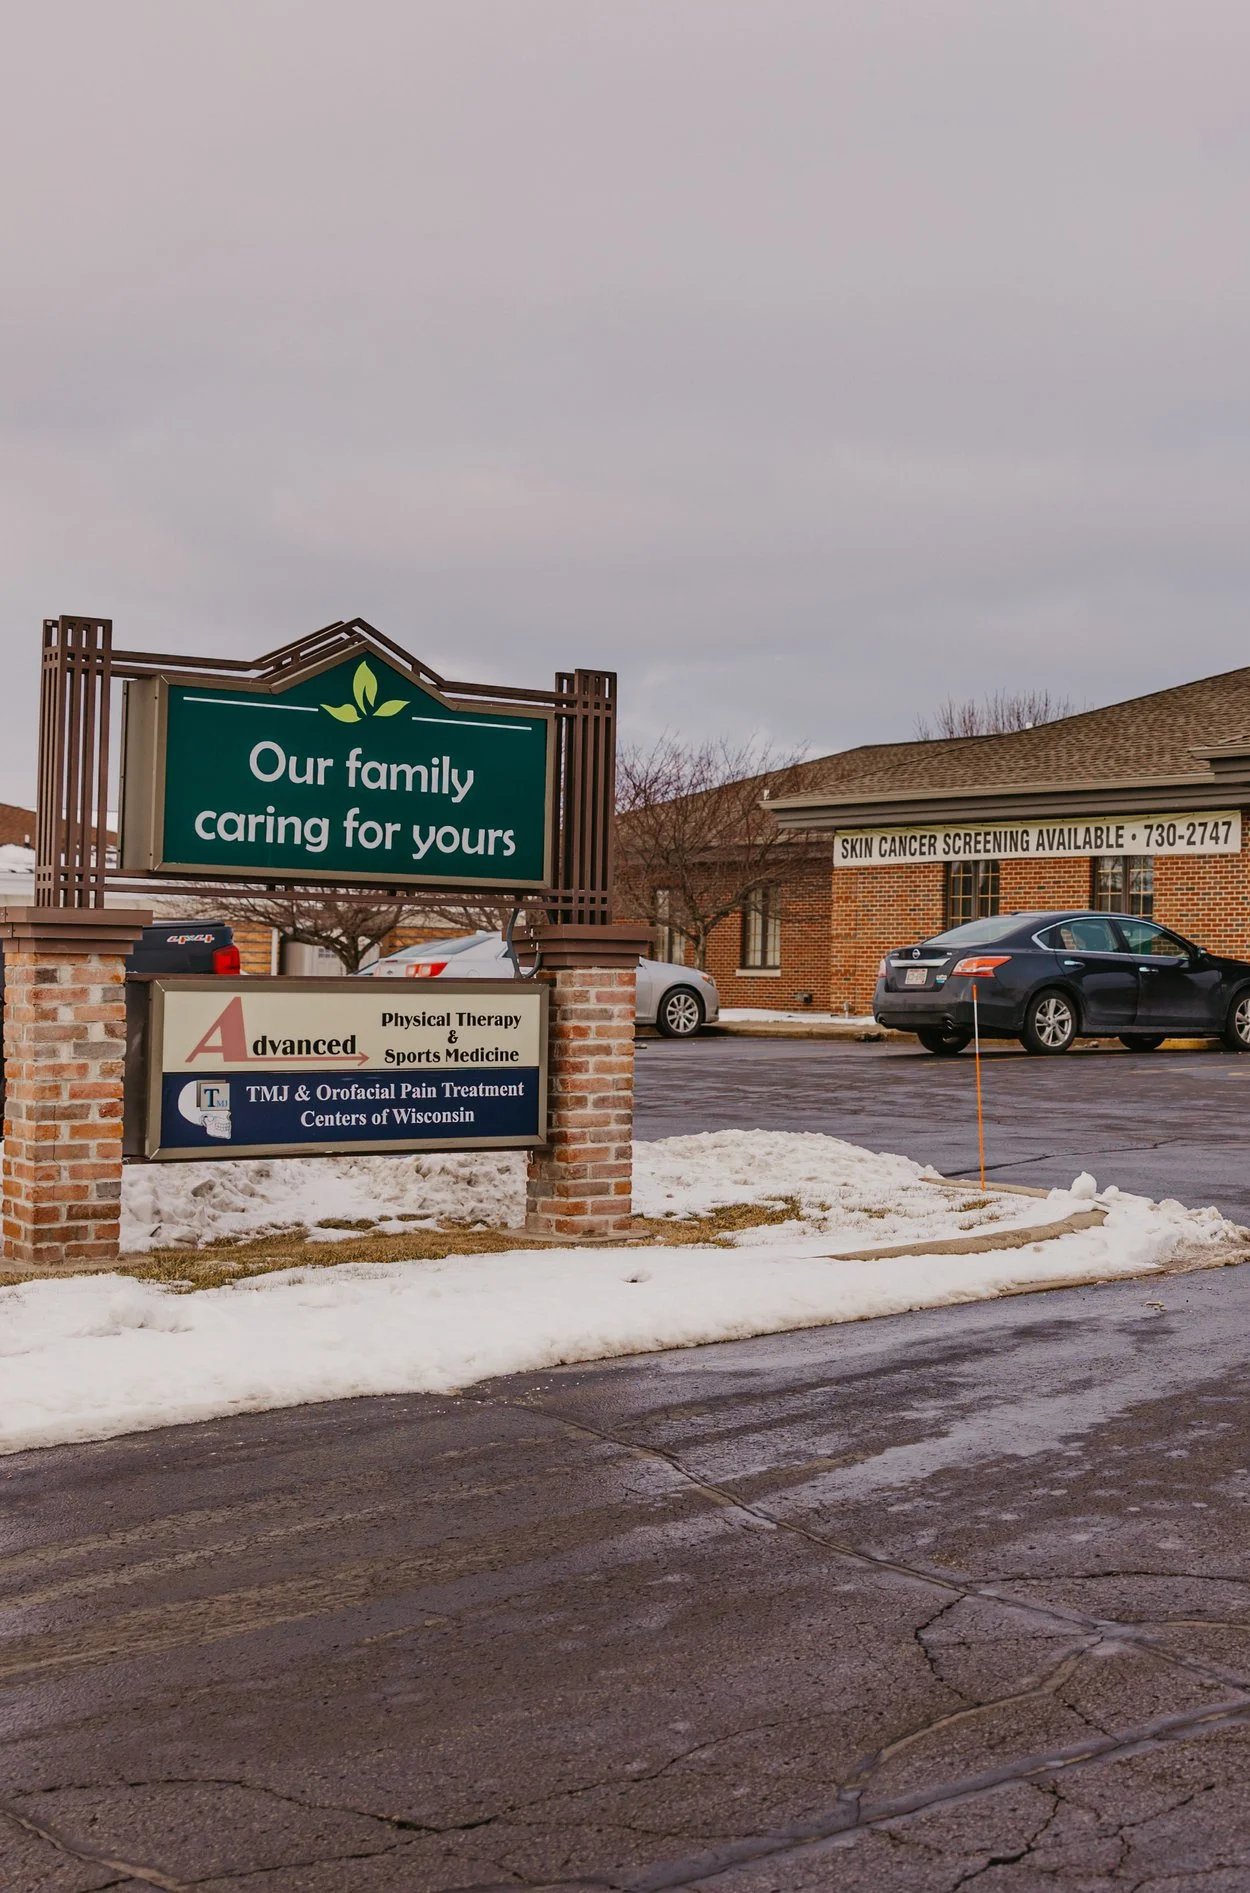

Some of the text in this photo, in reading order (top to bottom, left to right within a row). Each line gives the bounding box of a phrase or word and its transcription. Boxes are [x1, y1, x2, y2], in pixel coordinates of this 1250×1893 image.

[249, 740, 475, 803] Our family
[194, 805, 516, 860] caring for yours
[841, 820, 1232, 859] SKIN CANCER SCREENING AVAILABLE 730-2747
[185, 996, 356, 1063] Advanced
[382, 1011, 522, 1030] Physical Therapy
[447, 1029, 459, 1044] &
[384, 1047, 519, 1066] Sports Medicine
[246, 1081, 525, 1103] TMJ & Orofacial Pain Treatment
[300, 1107, 475, 1127] Centers of Wisconsin
